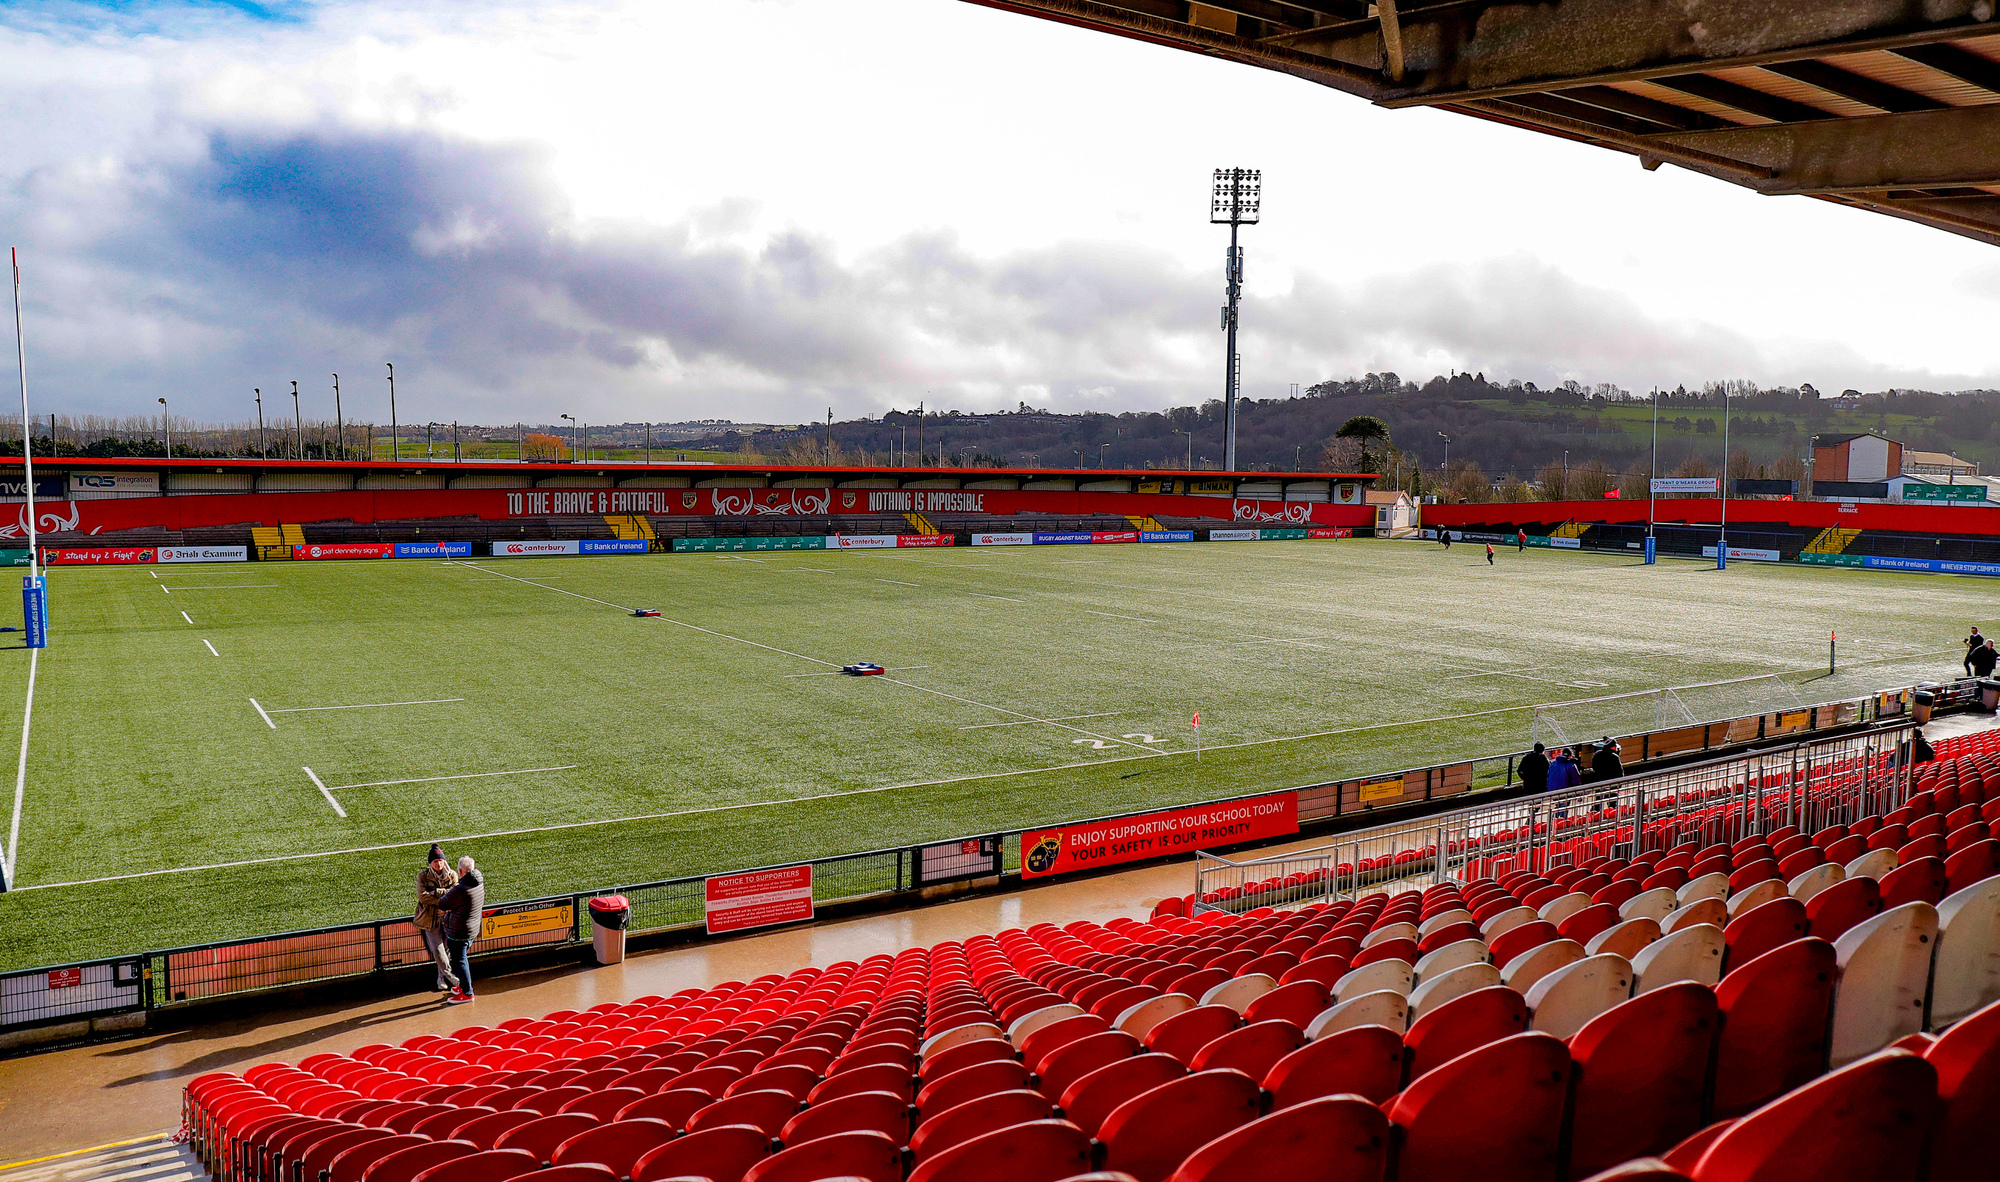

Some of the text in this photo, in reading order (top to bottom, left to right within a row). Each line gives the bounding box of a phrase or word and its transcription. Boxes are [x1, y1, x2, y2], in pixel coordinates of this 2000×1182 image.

[116, 475, 153, 484] integration
[507, 493, 522, 514] TO
[526, 492, 550, 514] THE
[553, 492, 594, 513] BRAVE
[598, 492, 607, 513] &
[611, 492, 669, 513] FAITHFUL
[868, 492, 911, 511] NOTHING
[914, 492, 924, 511] IS
[927, 492, 984, 512] IMPOSSIBLE
[412, 546, 429, 554] Bank
[524, 544, 566, 552] canterbury
[620, 542, 643, 550] Ireland
[113, 552, 135, 560] Fight
[175, 550, 243, 559] Irish Examiner
[1071, 802, 1285, 846] ENJOY SUPPORTING YOUR SCHOOL TODAY
[1071, 822, 1251, 861] YOUR SAFETY IS OUR PRIORITY
[719, 877, 743, 887] NOTICE
[755, 870, 800, 882] SUPPORTERS
[524, 904, 538, 912] Each
